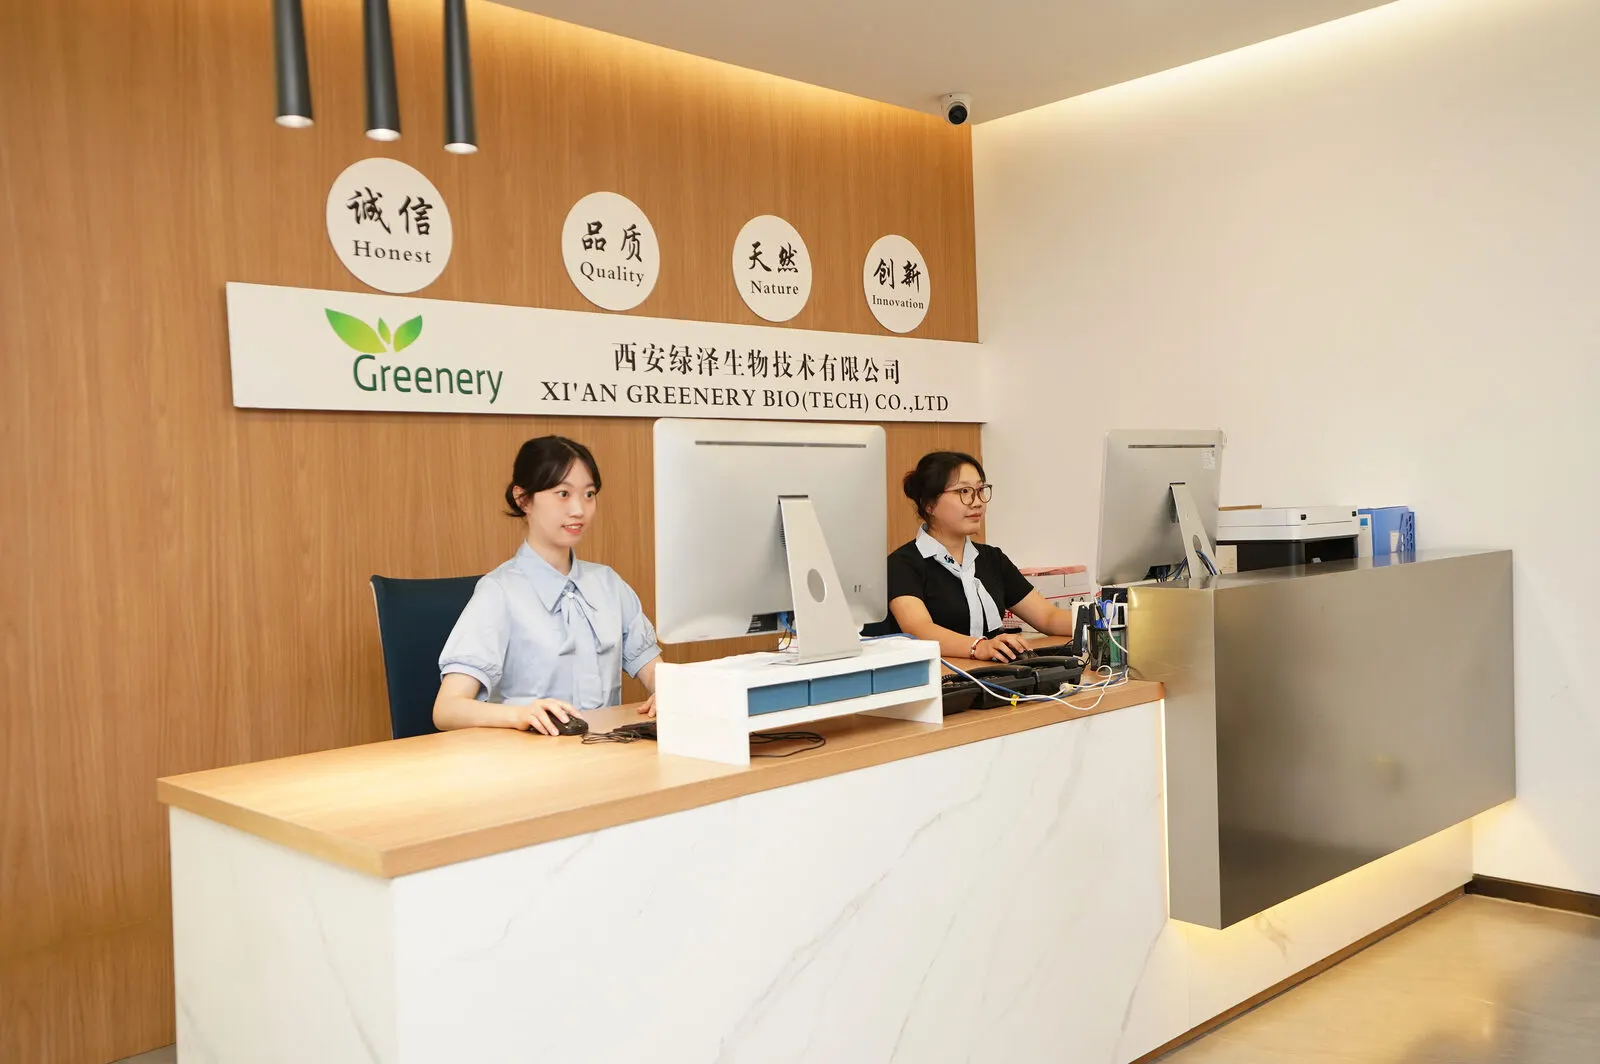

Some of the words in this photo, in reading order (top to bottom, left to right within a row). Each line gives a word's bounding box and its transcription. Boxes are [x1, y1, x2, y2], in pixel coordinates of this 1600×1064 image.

[346, 187, 433, 236] 诚信
[352, 239, 431, 263] Honest
[581, 221, 643, 262] 品质
[748, 242, 799, 273] 天然
[580, 261, 645, 287] Quality
[751, 280, 799, 296] Nature
[873, 258, 921, 293] 创新
[872, 294, 924, 310] Innovation
[353, 354, 503, 404] Greenery
[613, 342, 901, 386] 西安绿泽生物技术有限公司
[541, 381, 617, 402] XI'AN
[627, 385, 756, 407] GREENERY
[763, 389, 869, 413] BIO(TECH)
[875, 393, 949, 413] CO.,LTD
